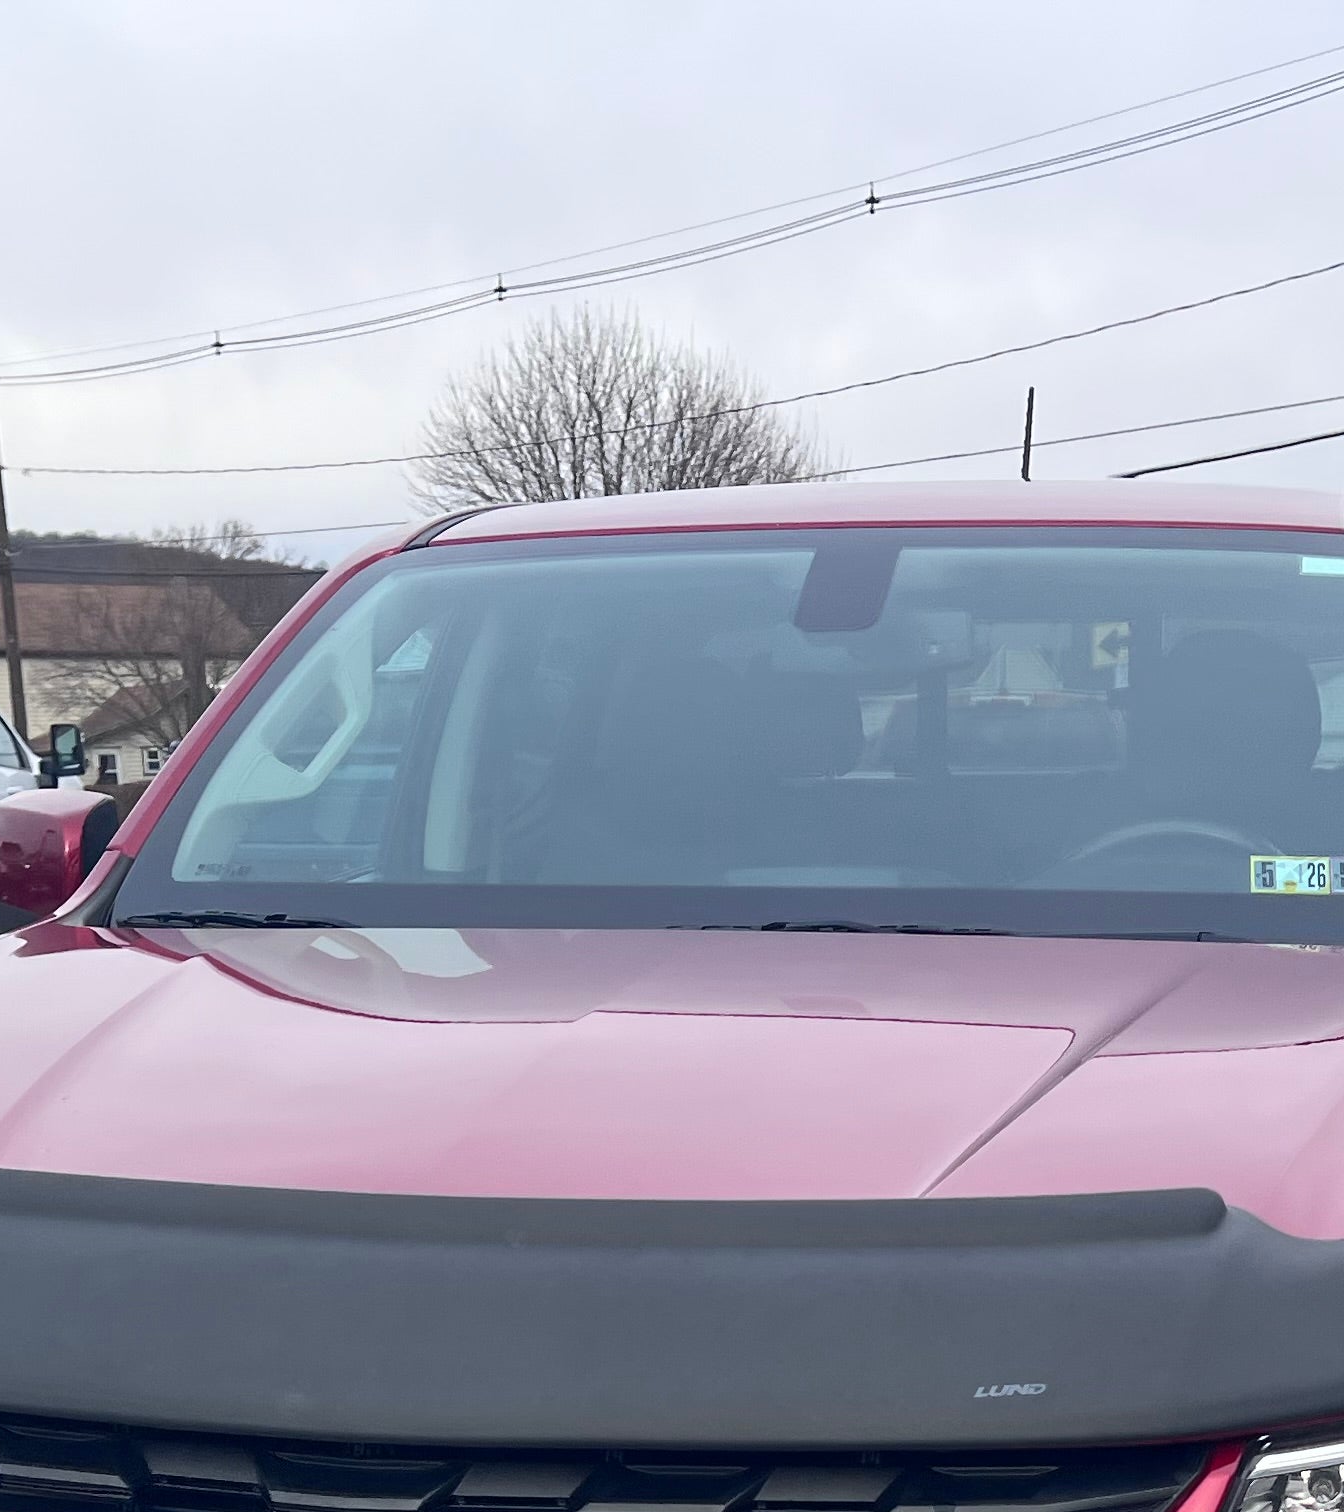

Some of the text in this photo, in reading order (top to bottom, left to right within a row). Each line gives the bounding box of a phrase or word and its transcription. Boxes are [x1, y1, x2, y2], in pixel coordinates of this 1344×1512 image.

[1261, 862, 1326, 888] 5 26
[973, 1383, 1047, 1398] LUND
